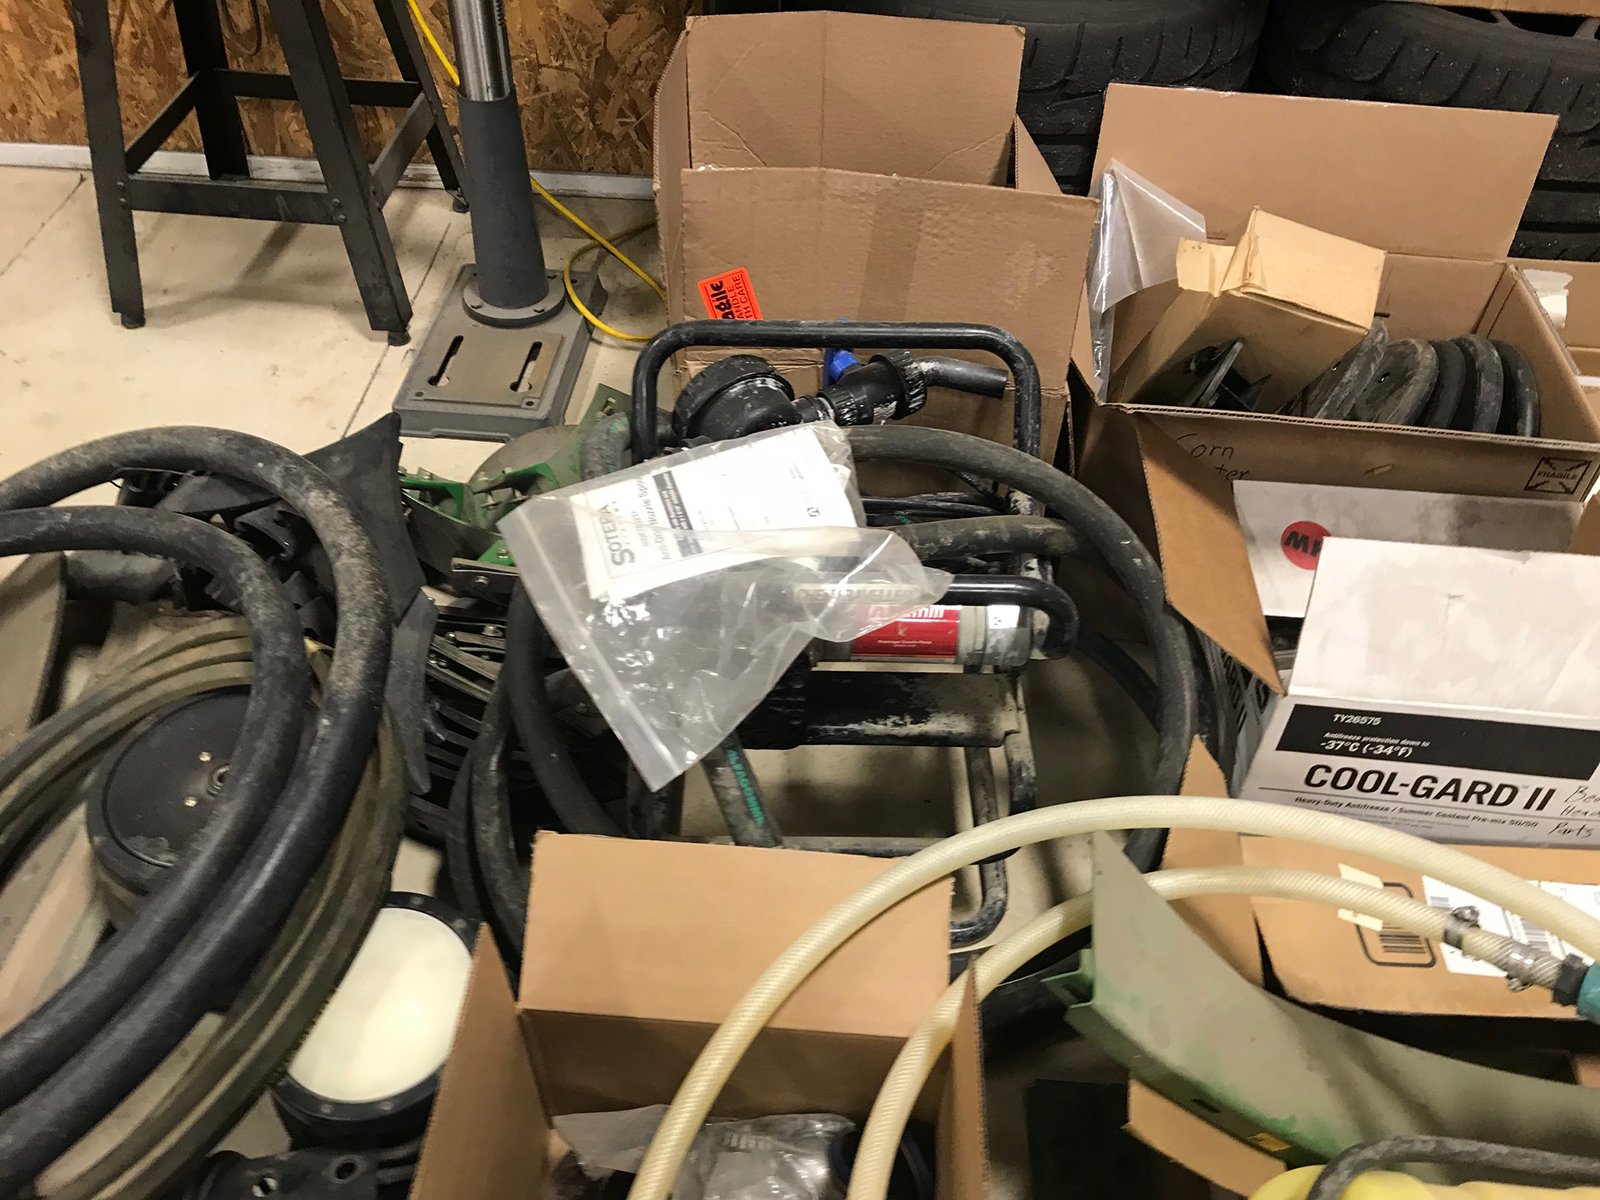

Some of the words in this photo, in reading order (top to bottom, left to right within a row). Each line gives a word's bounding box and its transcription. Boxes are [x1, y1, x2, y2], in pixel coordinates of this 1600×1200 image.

[710, 280, 735, 319] agile
[728, 285, 745, 319] ANDLE
[1323, 731, 1361, 741] Antifreeze
[1333, 713, 1382, 726] TY26575
[1304, 764, 1519, 808] COOL-GARD
